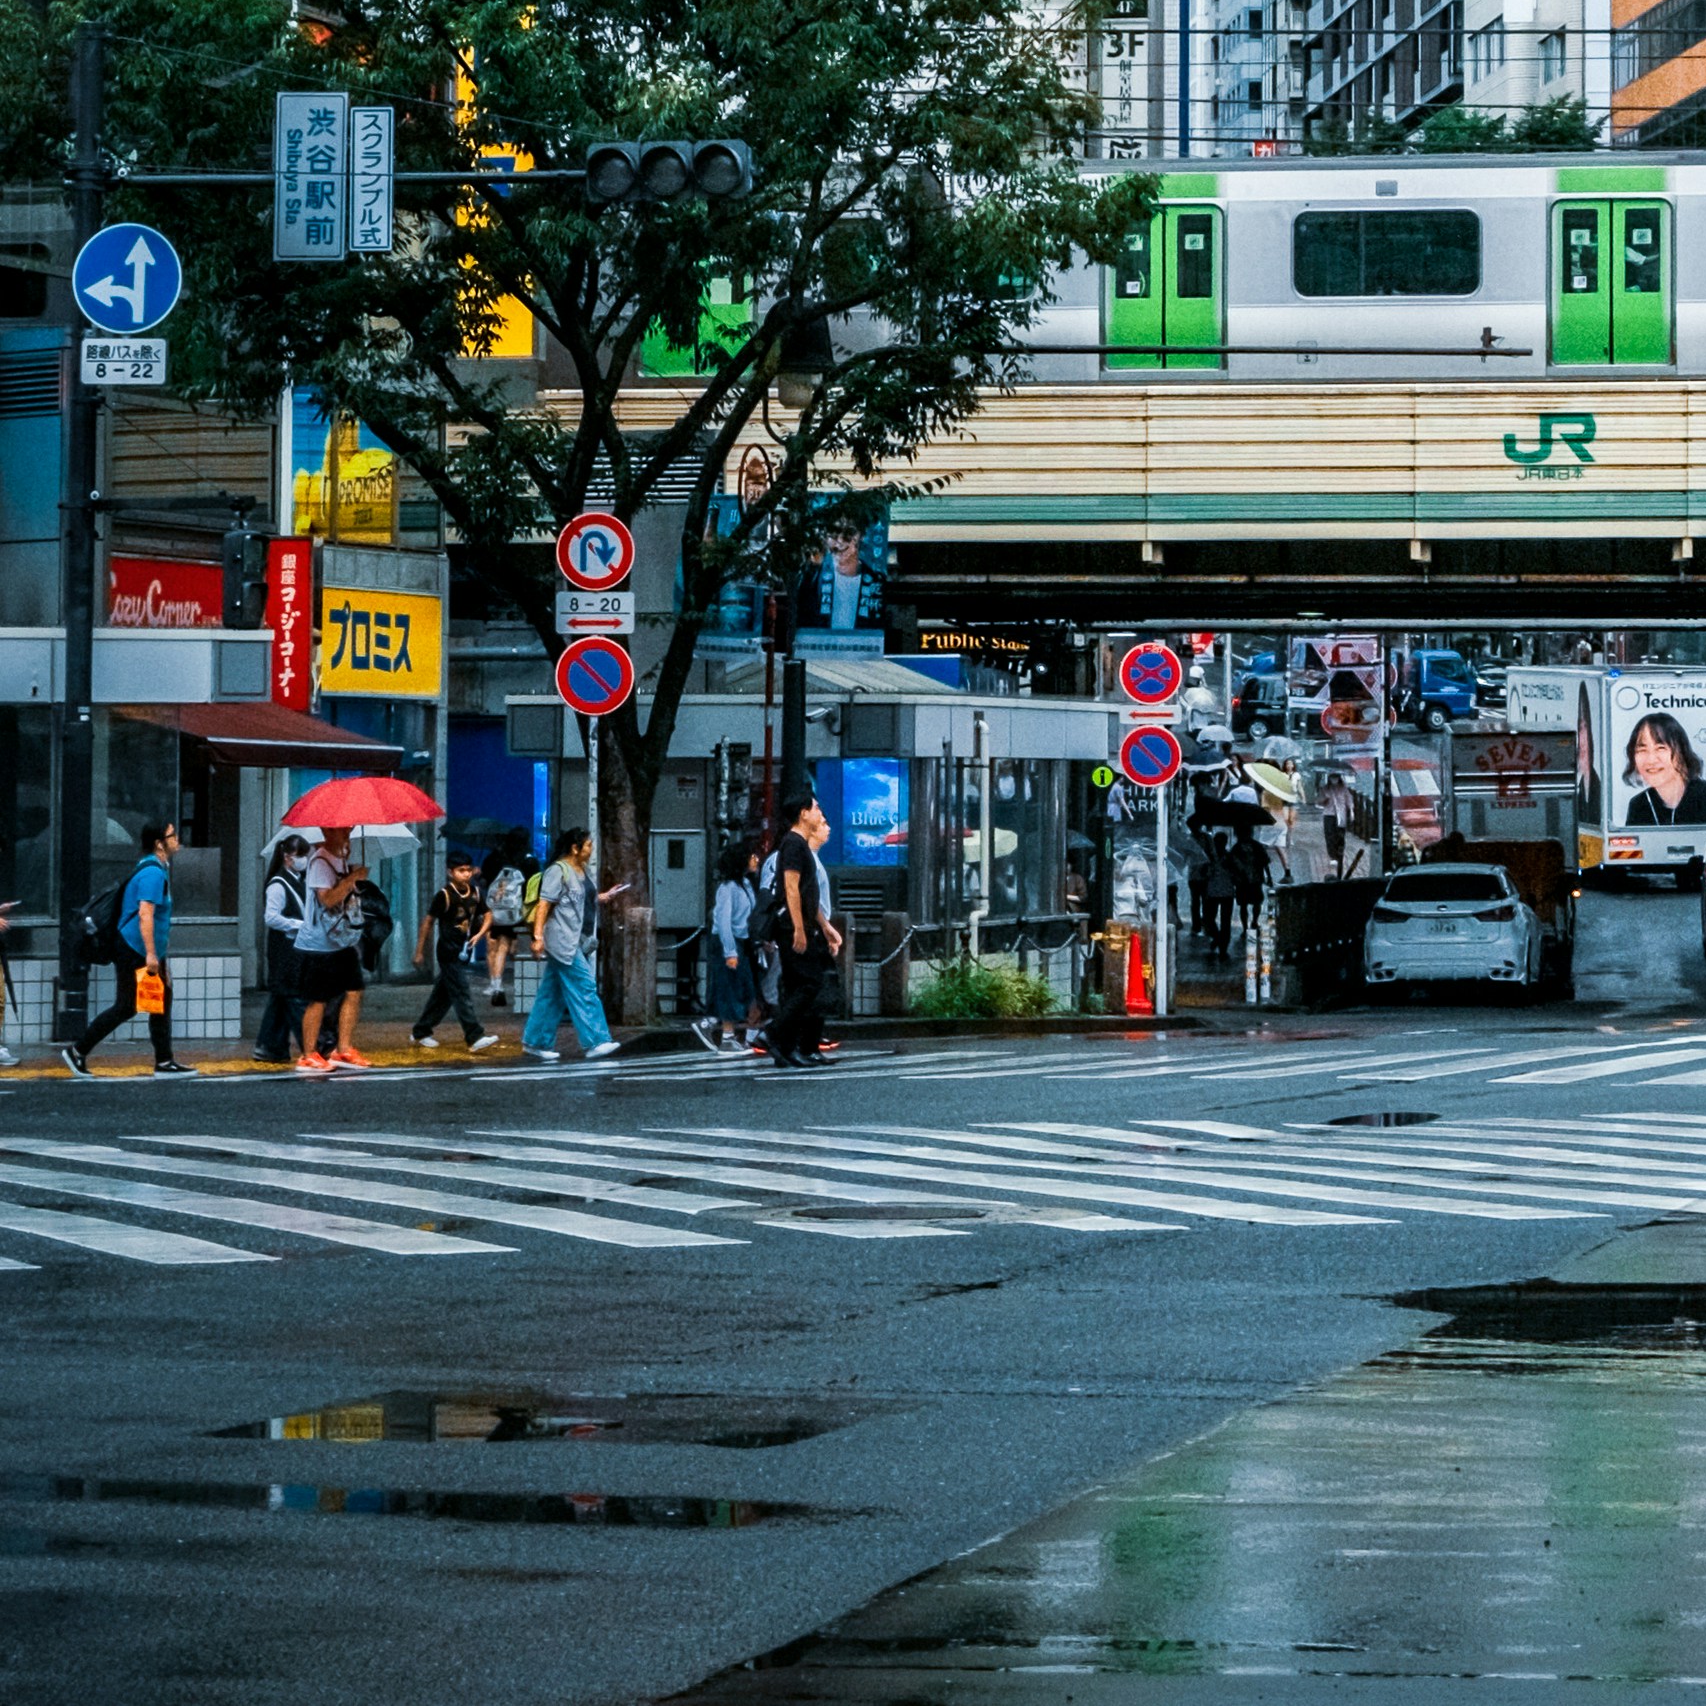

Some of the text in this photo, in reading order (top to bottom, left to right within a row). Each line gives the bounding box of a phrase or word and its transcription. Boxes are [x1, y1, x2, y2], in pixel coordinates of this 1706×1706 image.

[1106, 32, 1145, 58] 3F
[284, 128, 304, 230] Shibuya Sta.
[304, 107, 337, 246] 渋谷駅前
[359, 113, 384, 246] スクランブル式
[1502, 411, 1597, 464] JR
[1516, 465, 1585, 481] JR東日本
[277, 552, 302, 698] 銀座コージーコーナー
[328, 599, 413, 673] プロミス
[1475, 737, 1552, 771] SEVEN
[851, 811, 887, 826] Blue
